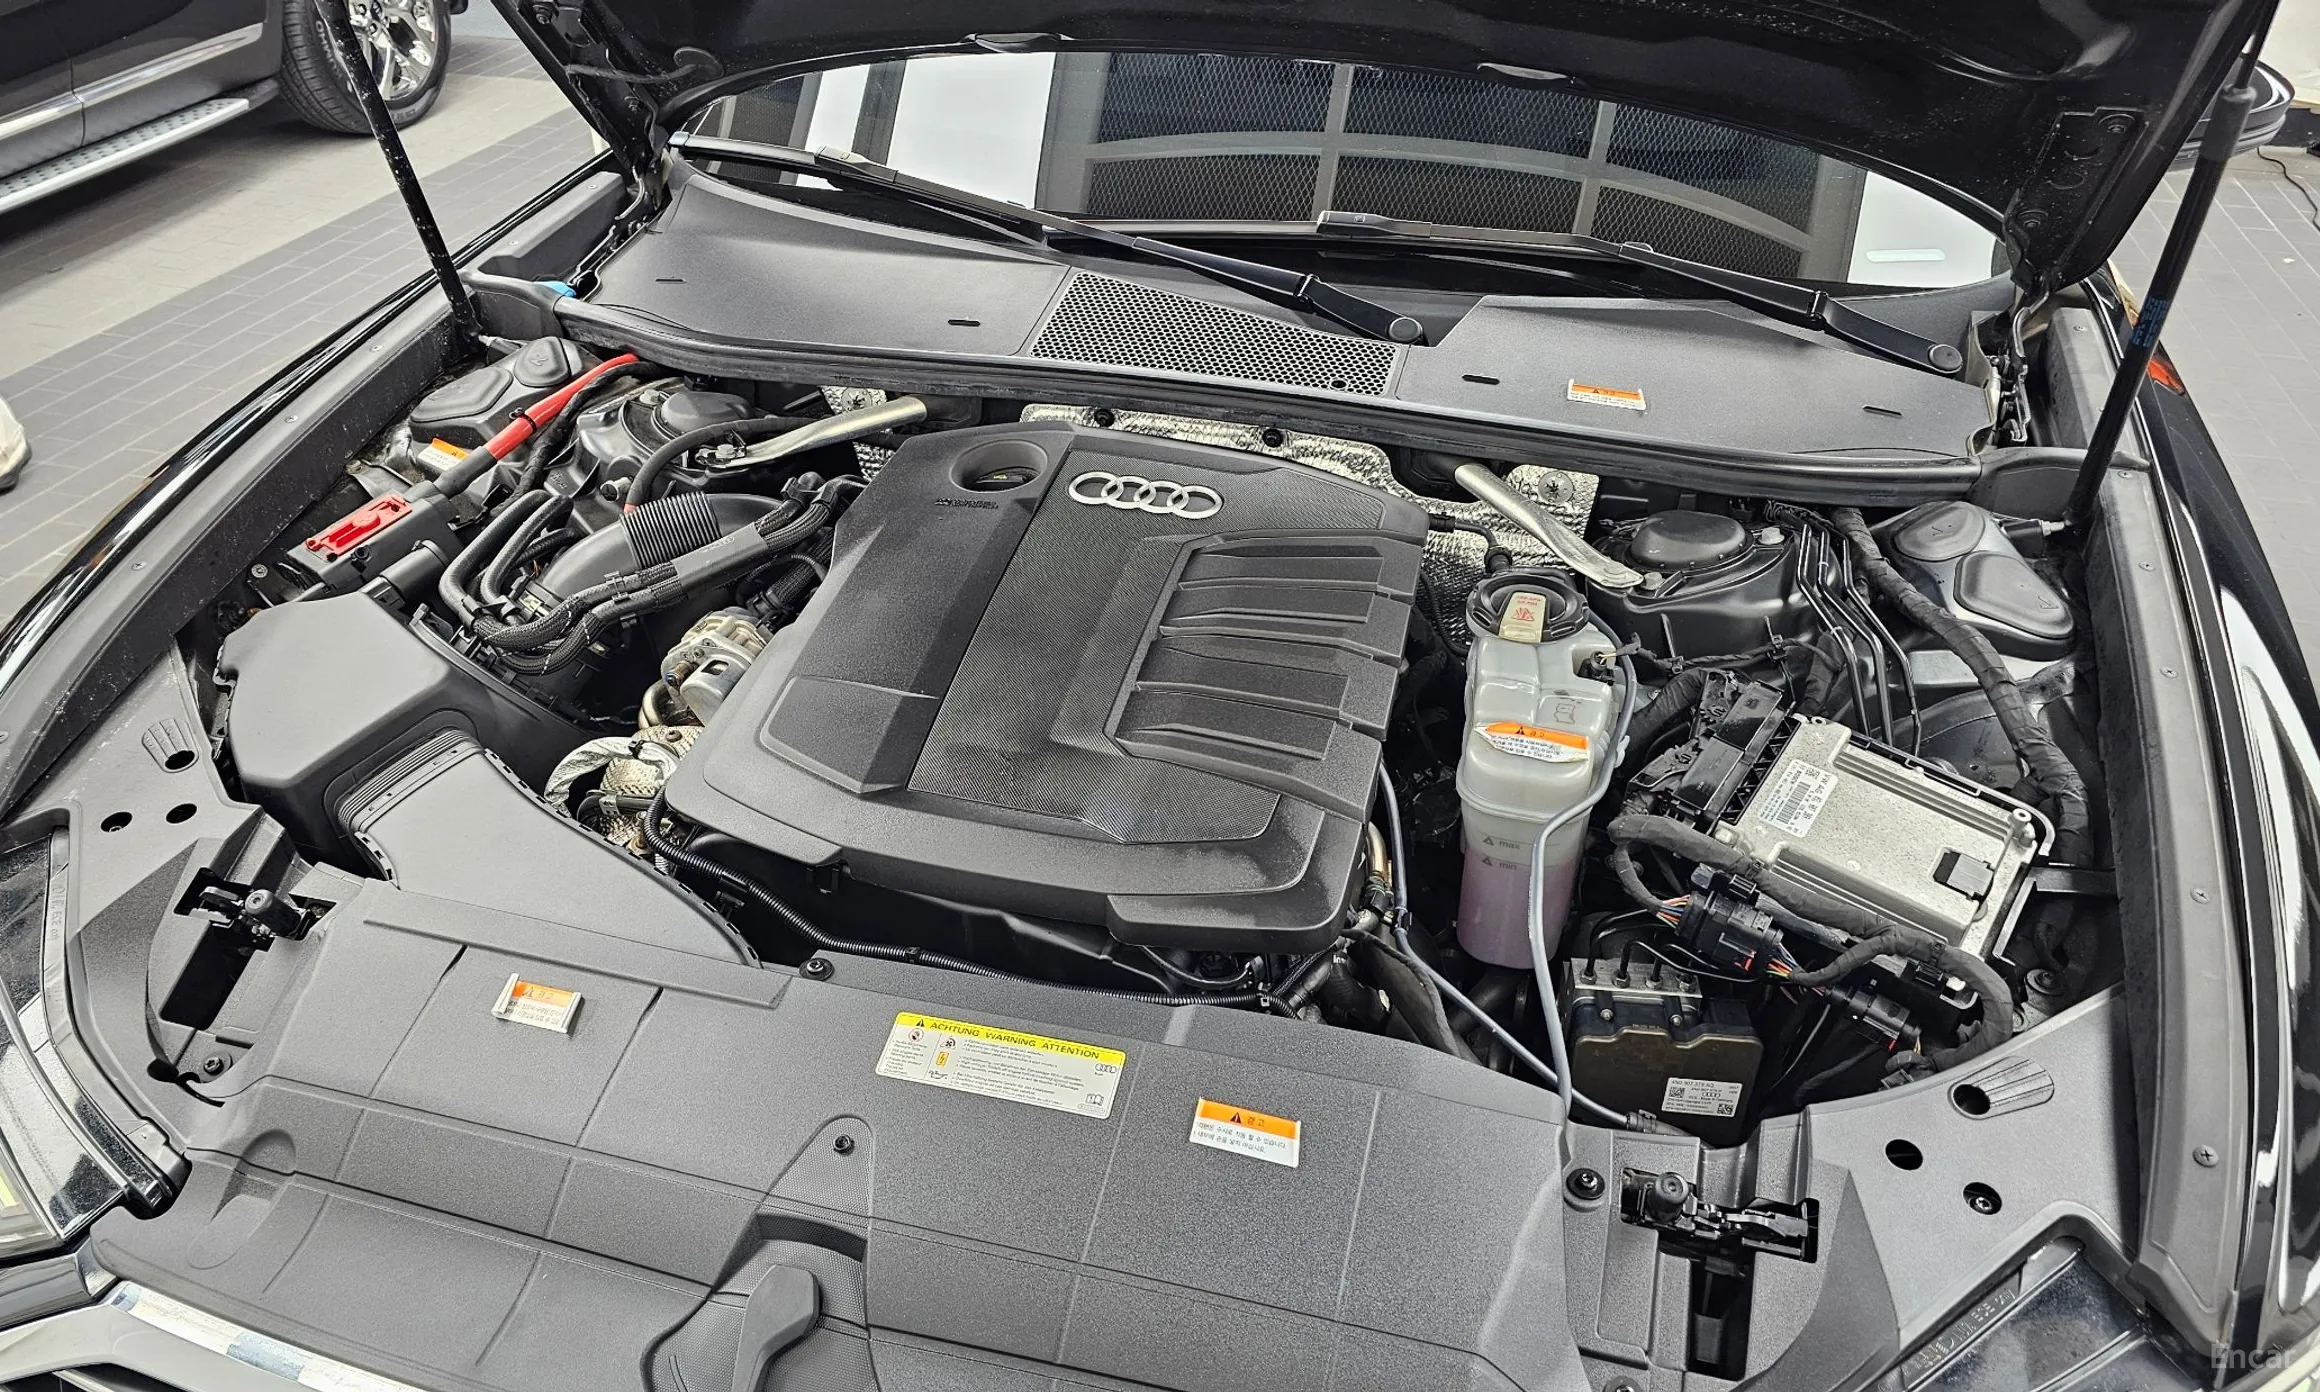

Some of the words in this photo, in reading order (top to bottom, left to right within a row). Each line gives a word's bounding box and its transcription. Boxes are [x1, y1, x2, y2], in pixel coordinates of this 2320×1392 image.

[1499, 840, 1520, 850] max
[1499, 862, 1517, 870] min
[930, 1022, 980, 1037] ACHTUNG
[985, 1032, 1037, 1047] WARNING
[1042, 1043, 1100, 1060] ATTENTION
